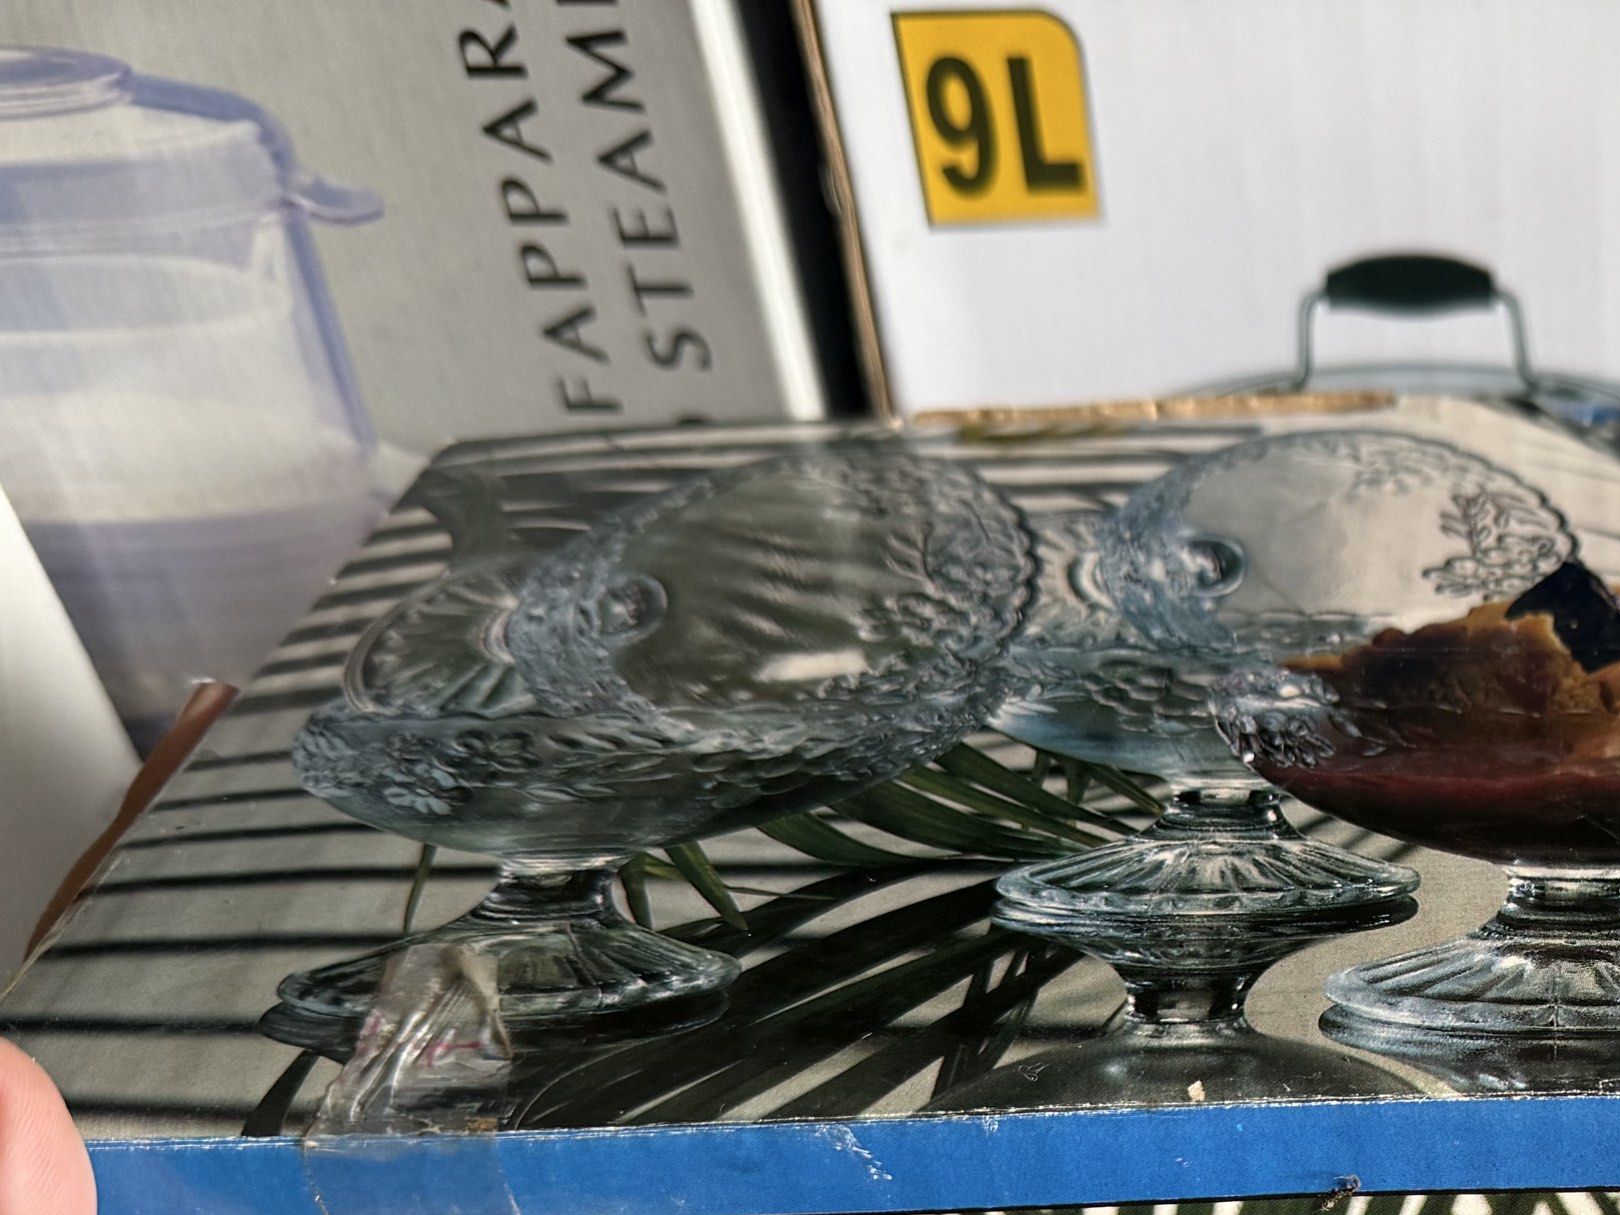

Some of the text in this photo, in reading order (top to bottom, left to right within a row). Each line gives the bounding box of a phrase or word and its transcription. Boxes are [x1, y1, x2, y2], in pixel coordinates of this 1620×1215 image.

[458, 0, 622, 416] FAPPAR
[556, 0, 711, 373] STEAM
[923, 54, 1083, 198] 9L
